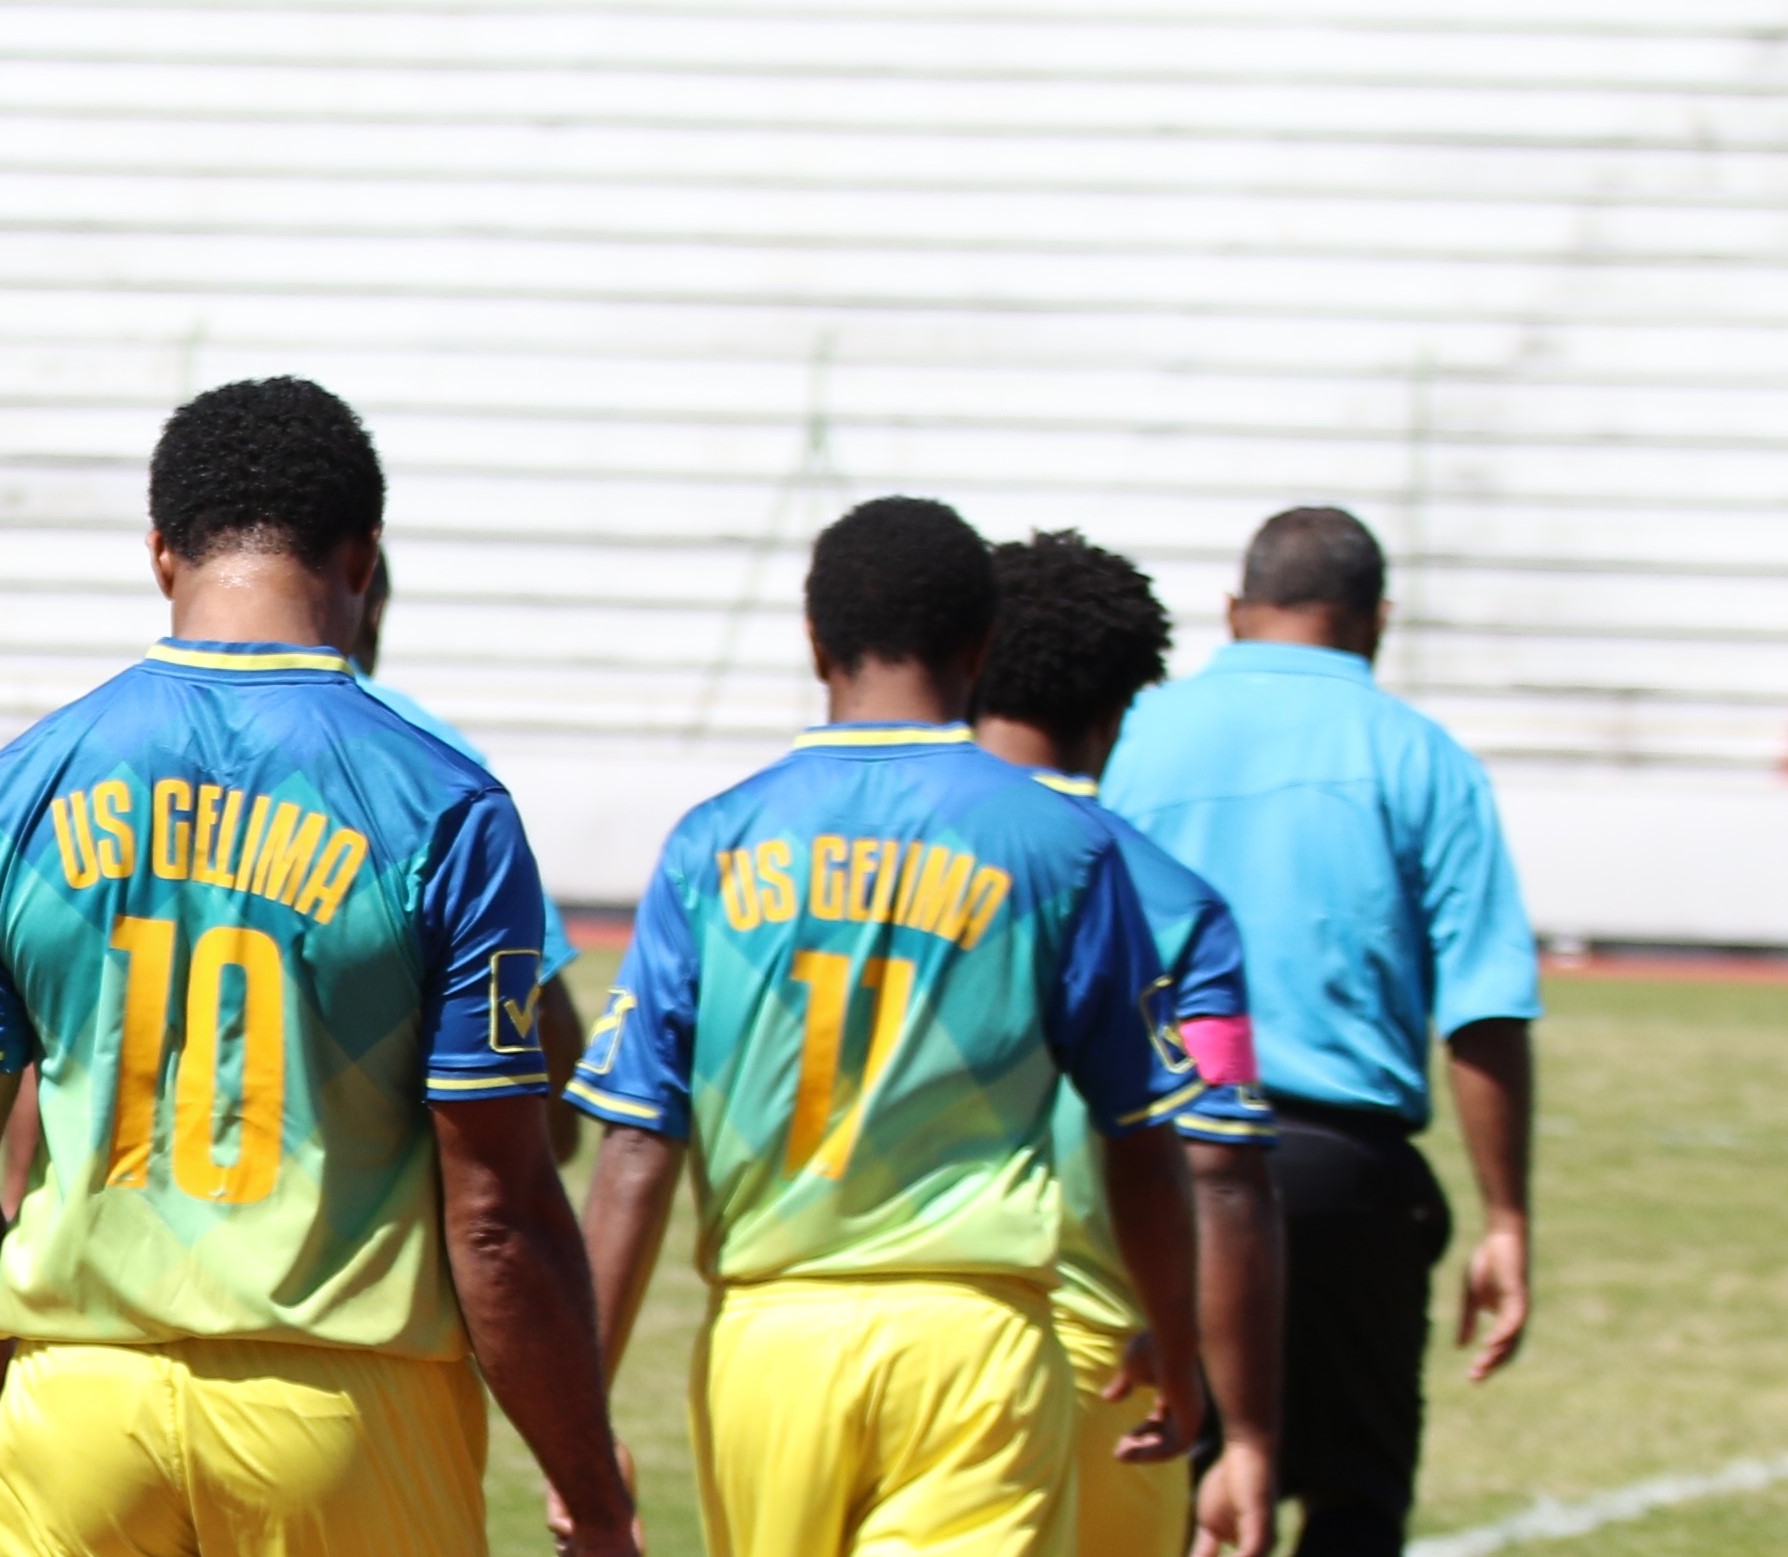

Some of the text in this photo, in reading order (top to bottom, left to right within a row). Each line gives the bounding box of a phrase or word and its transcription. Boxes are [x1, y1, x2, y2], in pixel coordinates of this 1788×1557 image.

[50, 778, 370, 926] US GELIMA
[717, 834, 1014, 951] US GELIMA
[102, 914, 286, 1206] 10
[783, 949, 913, 1182] 11
